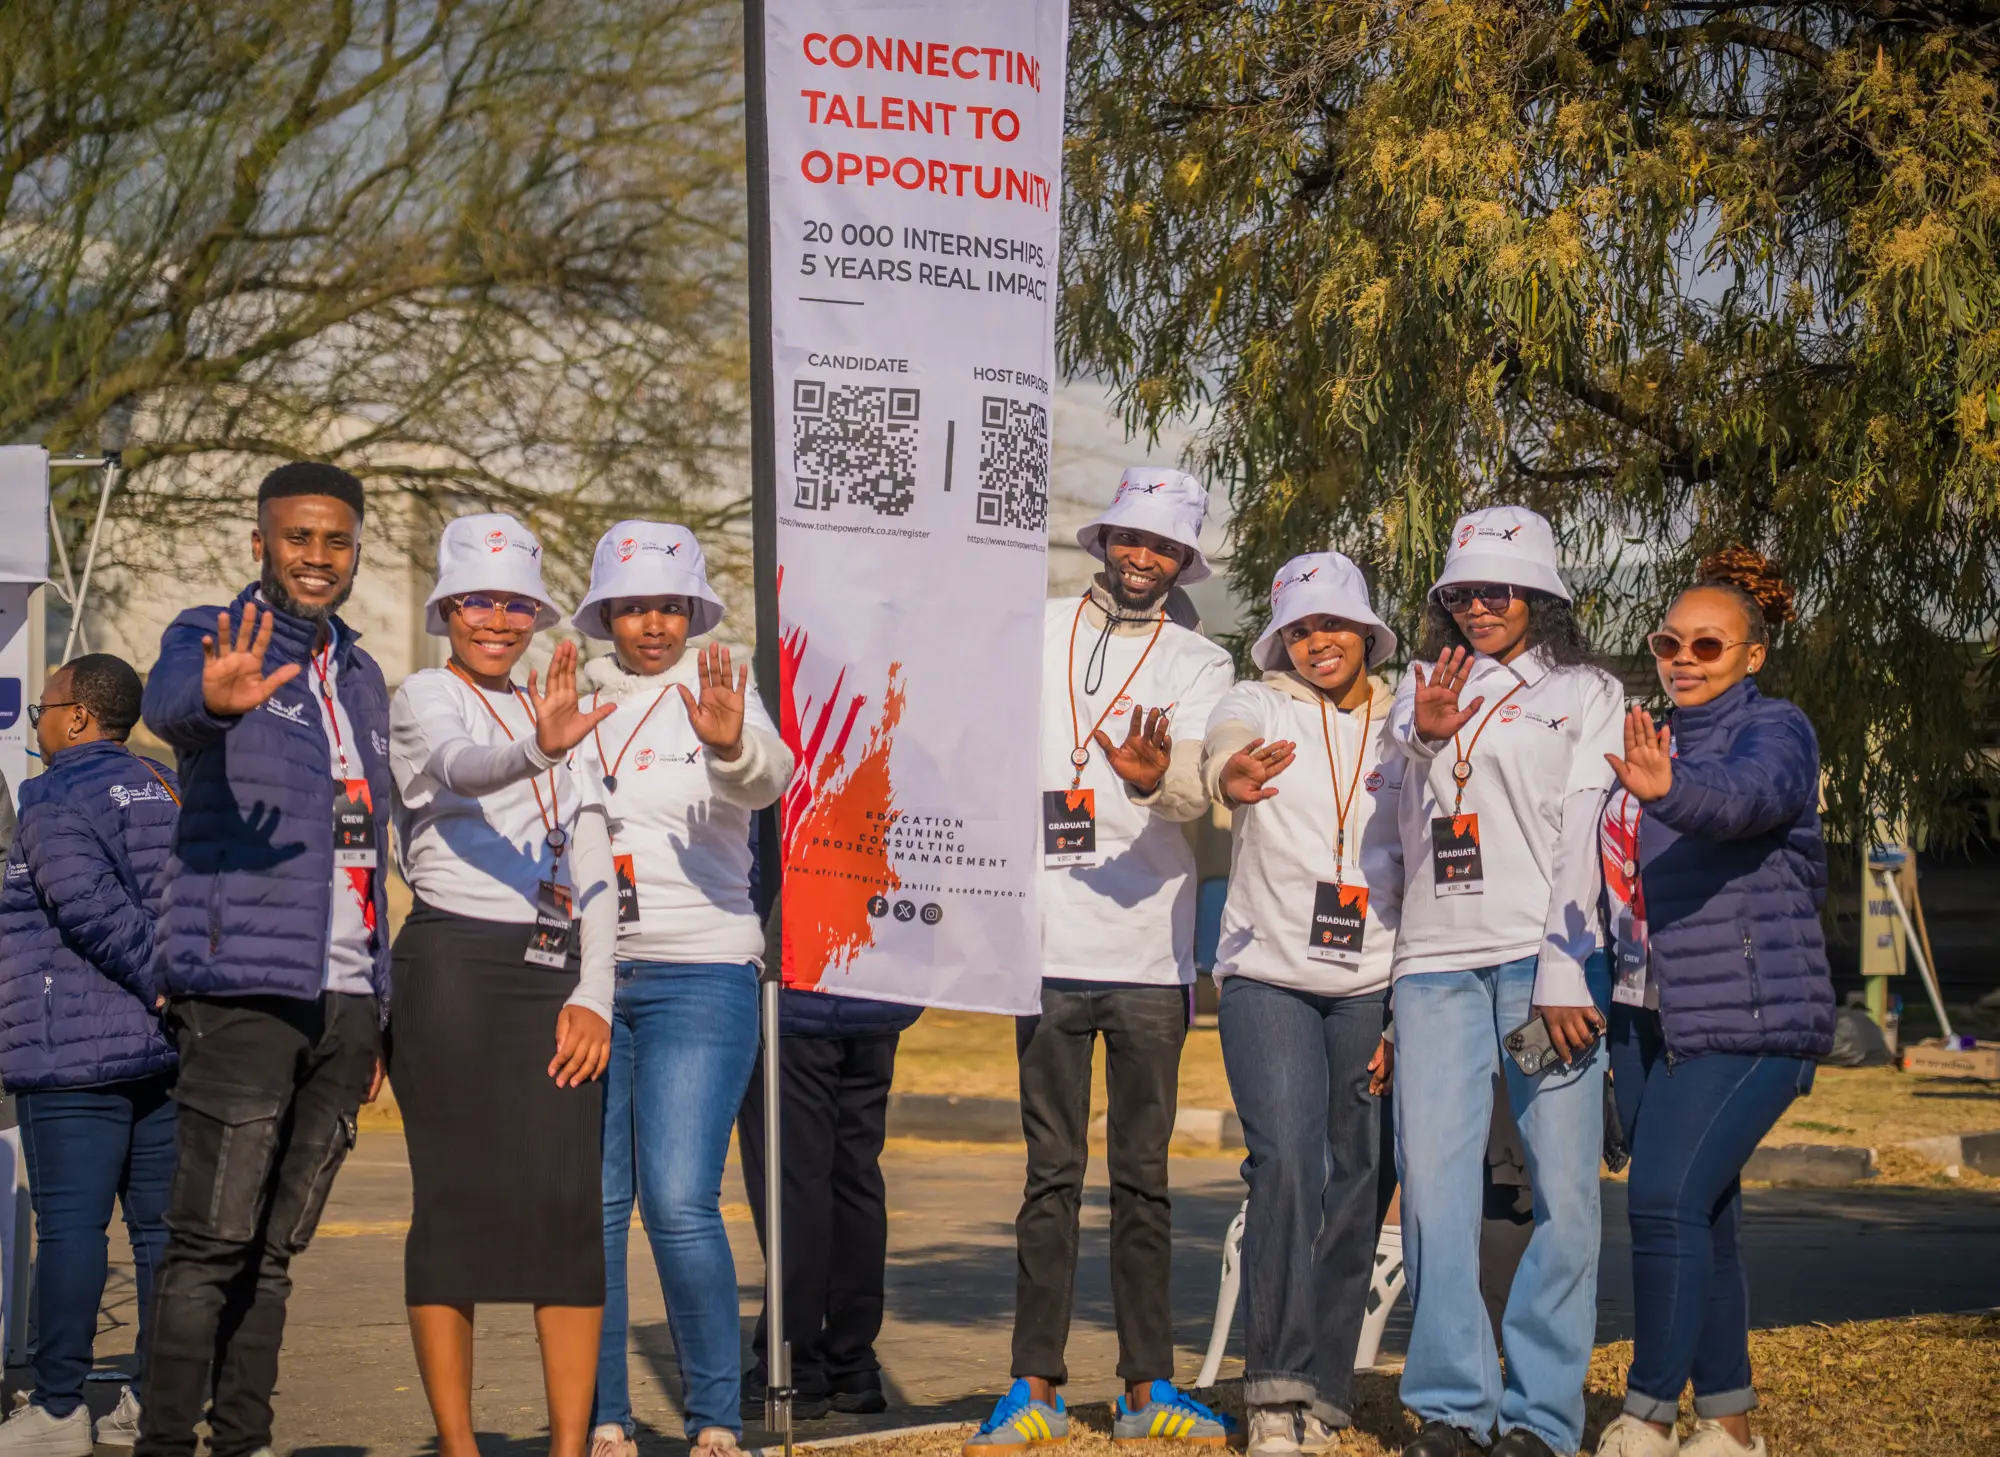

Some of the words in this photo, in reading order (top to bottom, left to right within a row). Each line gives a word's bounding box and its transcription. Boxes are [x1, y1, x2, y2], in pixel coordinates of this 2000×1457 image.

[803, 33, 1040, 92] CONNECTING
[801, 90, 956, 136] TALENT
[967, 106, 1020, 141] TO
[801, 150, 1051, 212] OPPORTUNITY
[803, 220, 833, 243] 20
[841, 224, 893, 247] 000
[800, 254, 817, 276] 5
[825, 256, 912, 282] YEARS
[919, 263, 981, 292] REAL
[988, 271, 1047, 303] IMPACT
[808, 353, 909, 372] CANDIDATE
[974, 366, 1013, 384] HOST
[341, 814, 364, 824] CREW
[866, 811, 963, 828] EDUCATION
[1048, 821, 1091, 830] GRADUATE
[873, 824, 954, 840] TRAINING
[859, 833, 965, 853] CONSULTING
[813, 837, 884, 857] PROJECT
[894, 851, 1007, 868] MANAGEMENT
[1437, 847, 1477, 859] GRADUATE
[538, 916, 569, 930] GRADUATE
[1316, 914, 1360, 928] GRADUATE
[1624, 954, 1640, 964] CREW
